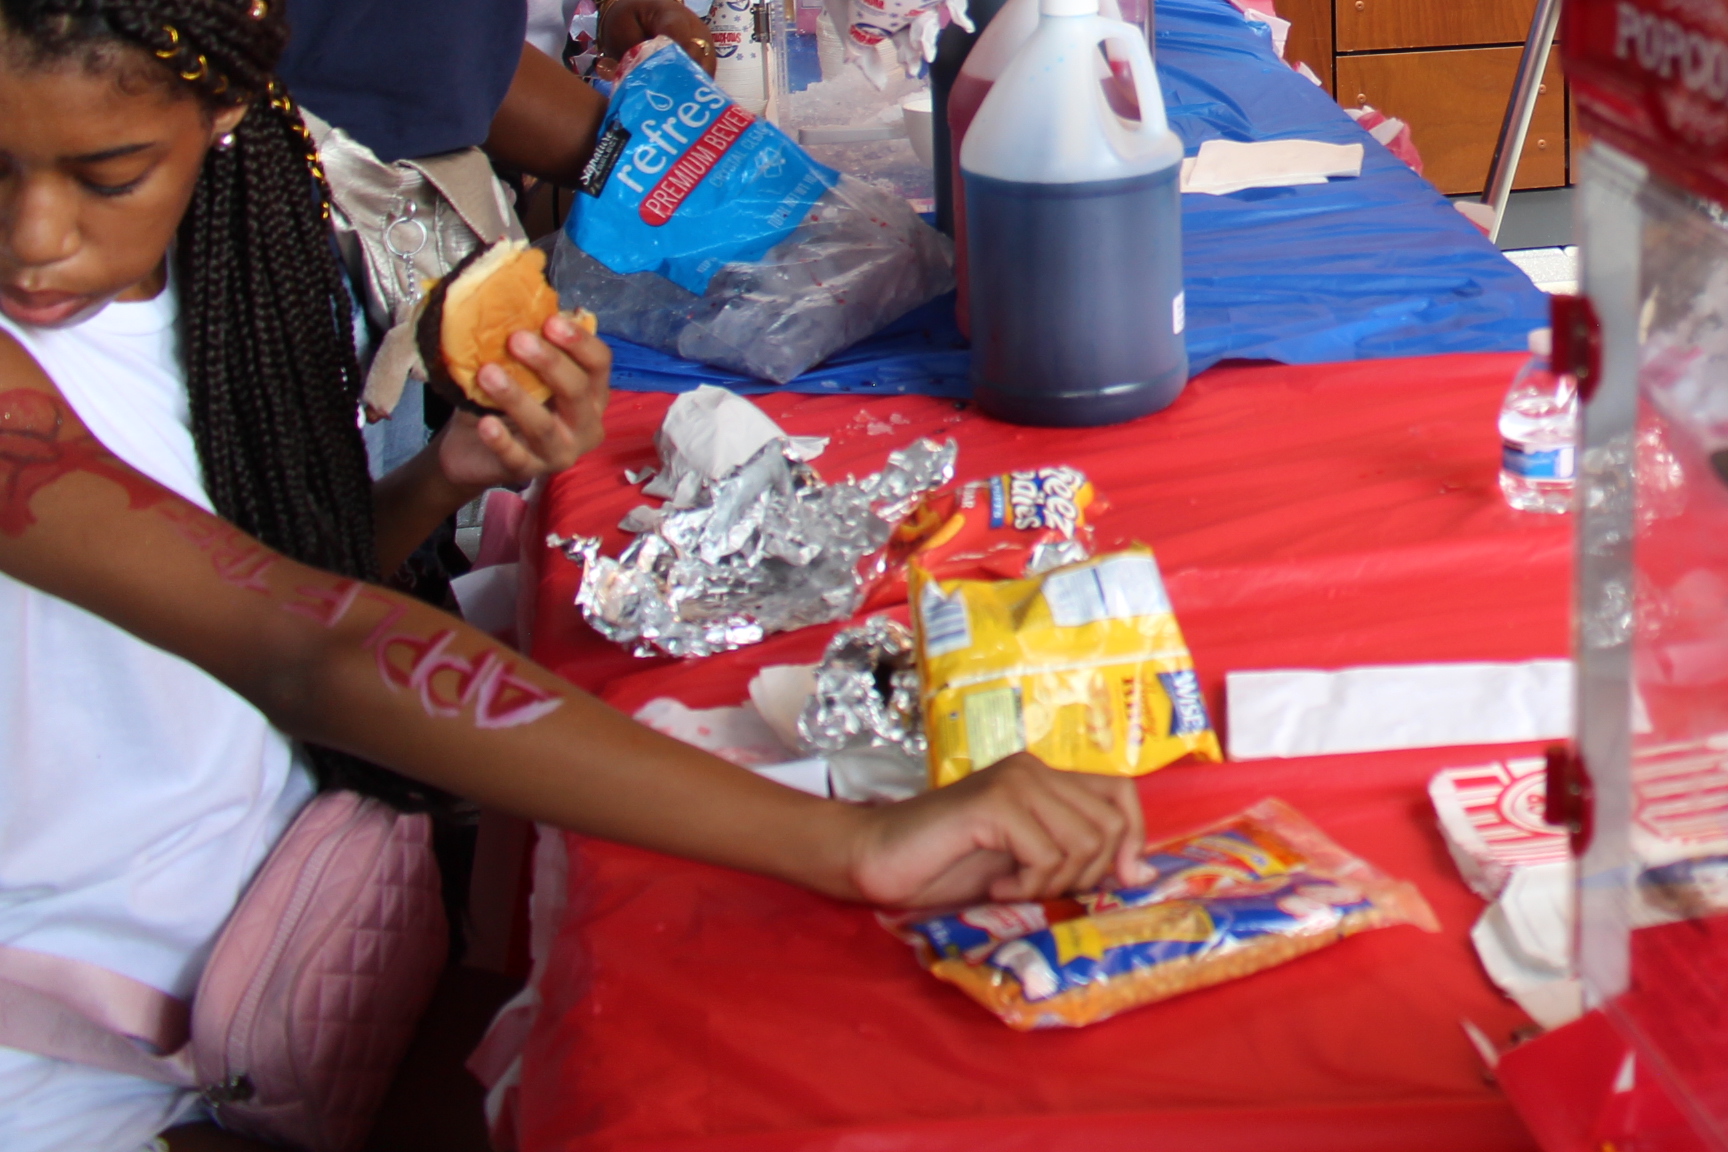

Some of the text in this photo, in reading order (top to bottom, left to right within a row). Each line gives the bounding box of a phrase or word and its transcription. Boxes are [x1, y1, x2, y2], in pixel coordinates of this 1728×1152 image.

[579, 130, 615, 186] Signature
[616, 84, 728, 194] refres
[645, 146, 717, 219] PREMIUM
[282, 578, 563, 729] APPLE
[1173, 670, 1206, 732] WISE
